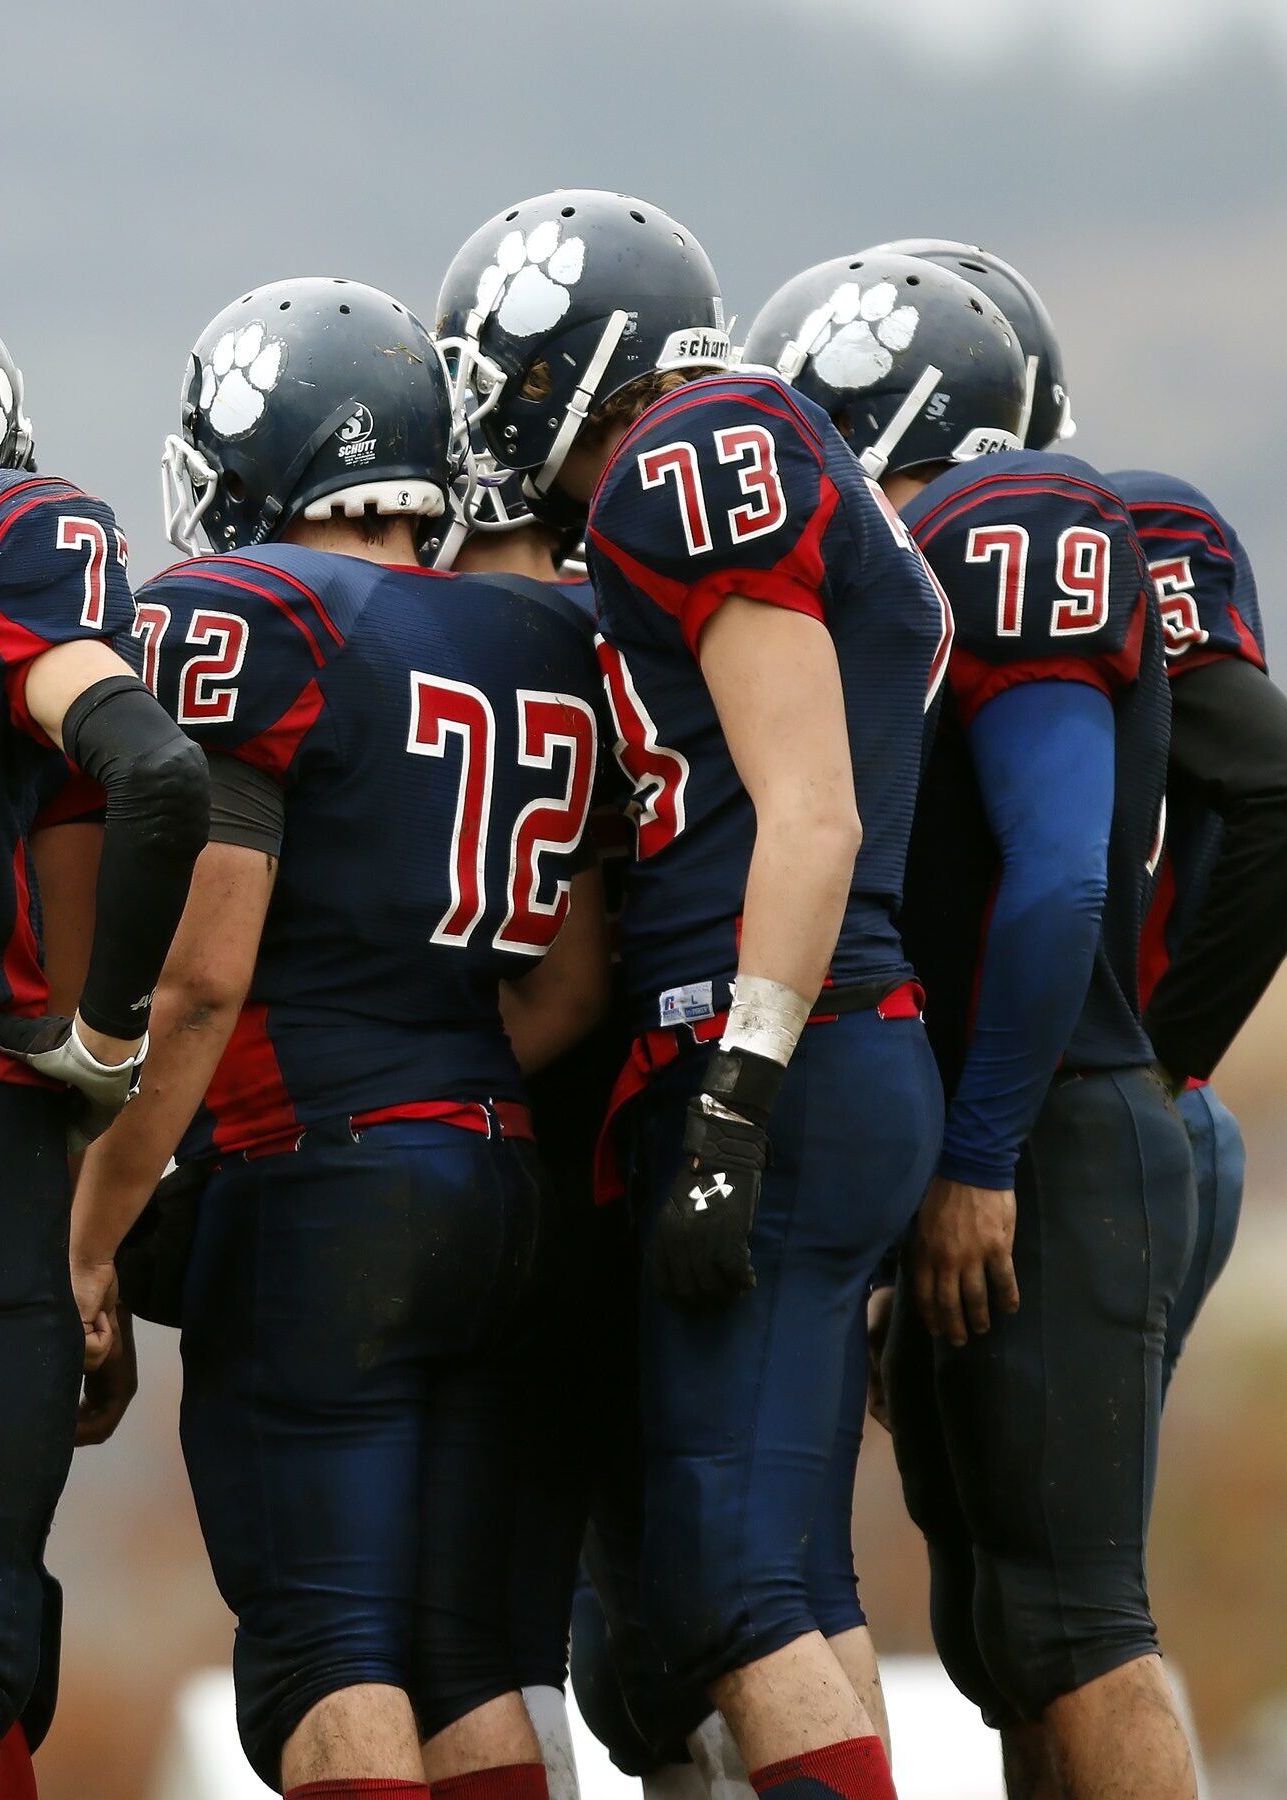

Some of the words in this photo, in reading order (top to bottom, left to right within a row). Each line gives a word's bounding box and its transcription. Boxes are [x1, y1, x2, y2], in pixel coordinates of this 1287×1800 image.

[338, 439, 377, 458] SCHUTT
[637, 425, 788, 556] 73
[965, 524, 1111, 637] 79
[131, 602, 250, 726] 72
[406, 671, 598, 957] 72
